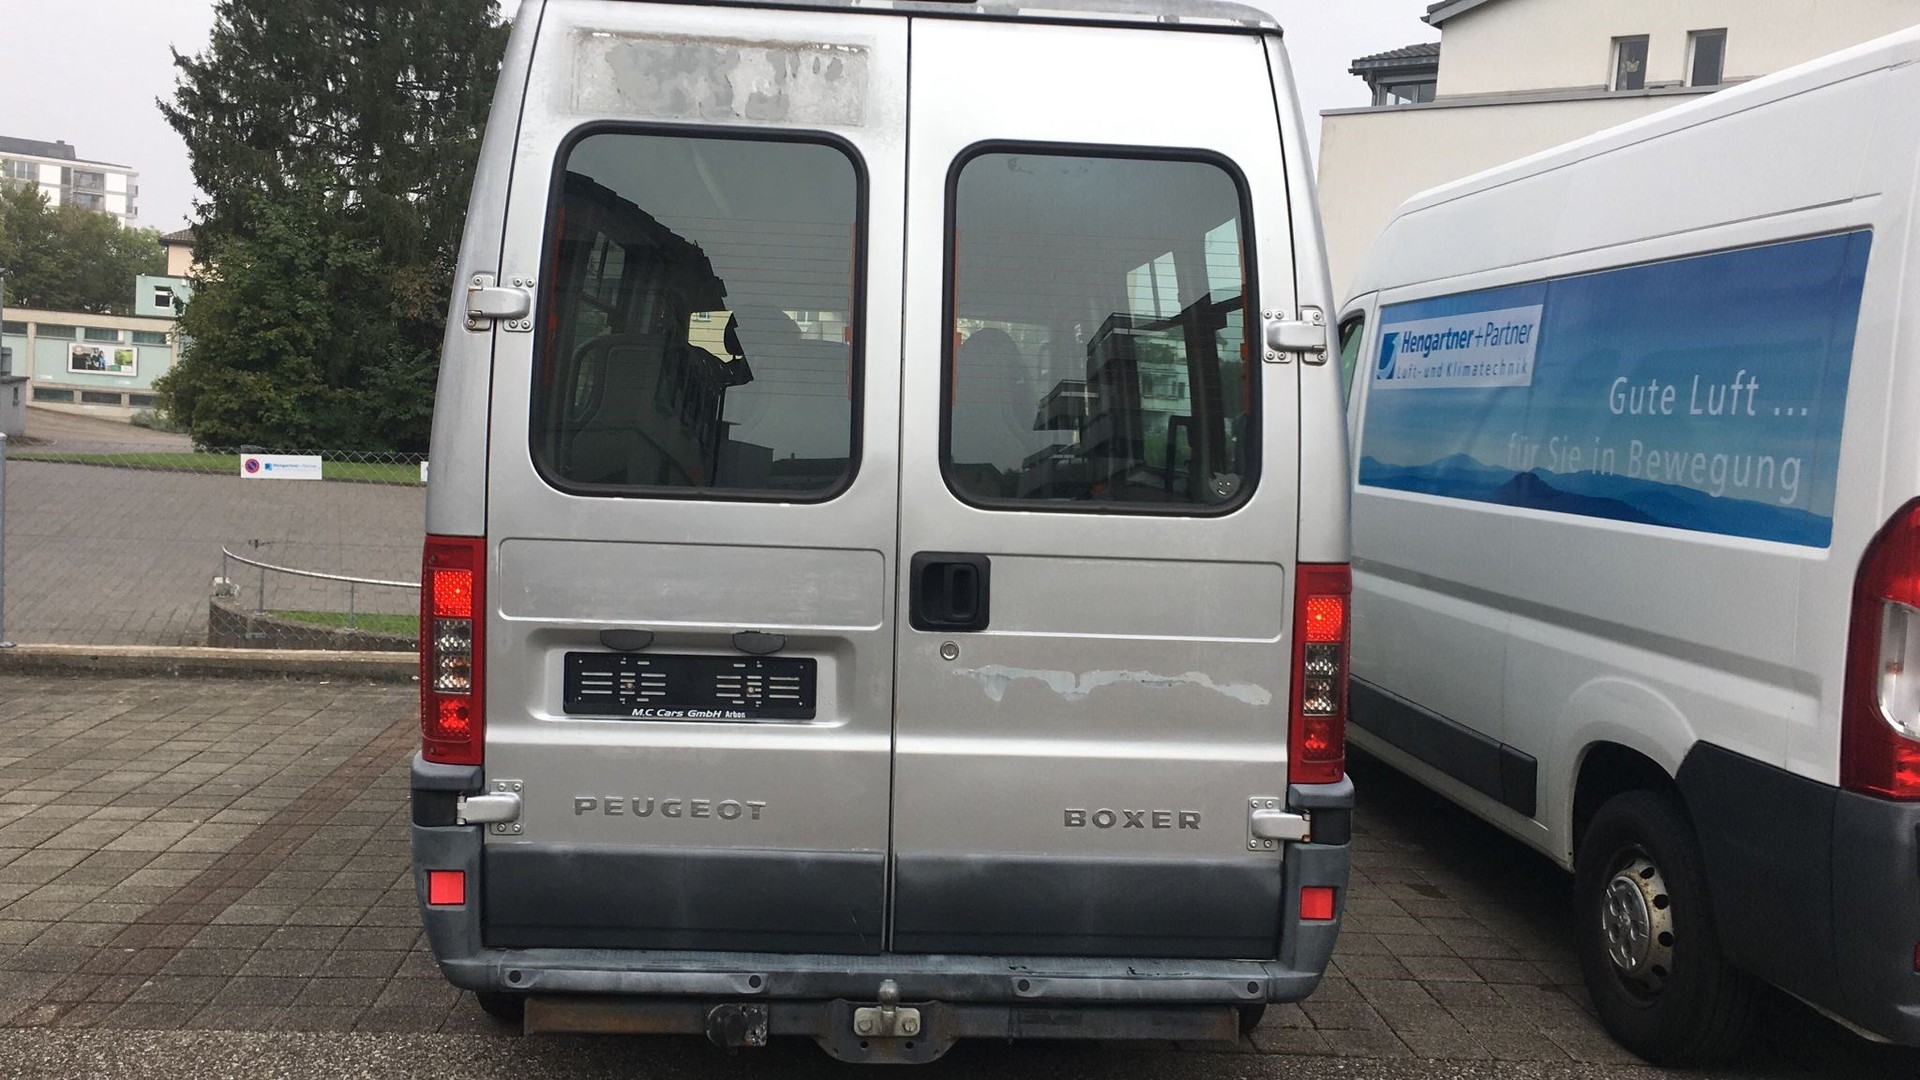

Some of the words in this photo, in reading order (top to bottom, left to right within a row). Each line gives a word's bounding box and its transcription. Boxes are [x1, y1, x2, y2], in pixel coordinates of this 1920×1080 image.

[1401, 321, 1534, 358] Hengartner+Partner
[1424, 362, 1442, 379] und
[1445, 358, 1527, 378] Klimatechnik
[1608, 376, 1676, 416] Gute
[1689, 369, 1760, 416] Luft
[1507, 432, 1540, 470] für
[1548, 435, 1581, 472] Sie
[1592, 436, 1615, 476] in
[1627, 439, 1801, 505] Bewegung
[631, 708, 654, 717] M.C
[656, 709, 684, 718] Cars
[687, 709, 723, 719] GmbH
[725, 710, 746, 719] Arbon
[574, 796, 767, 821] PEUGEOT
[1063, 808, 1202, 830] BOXER
